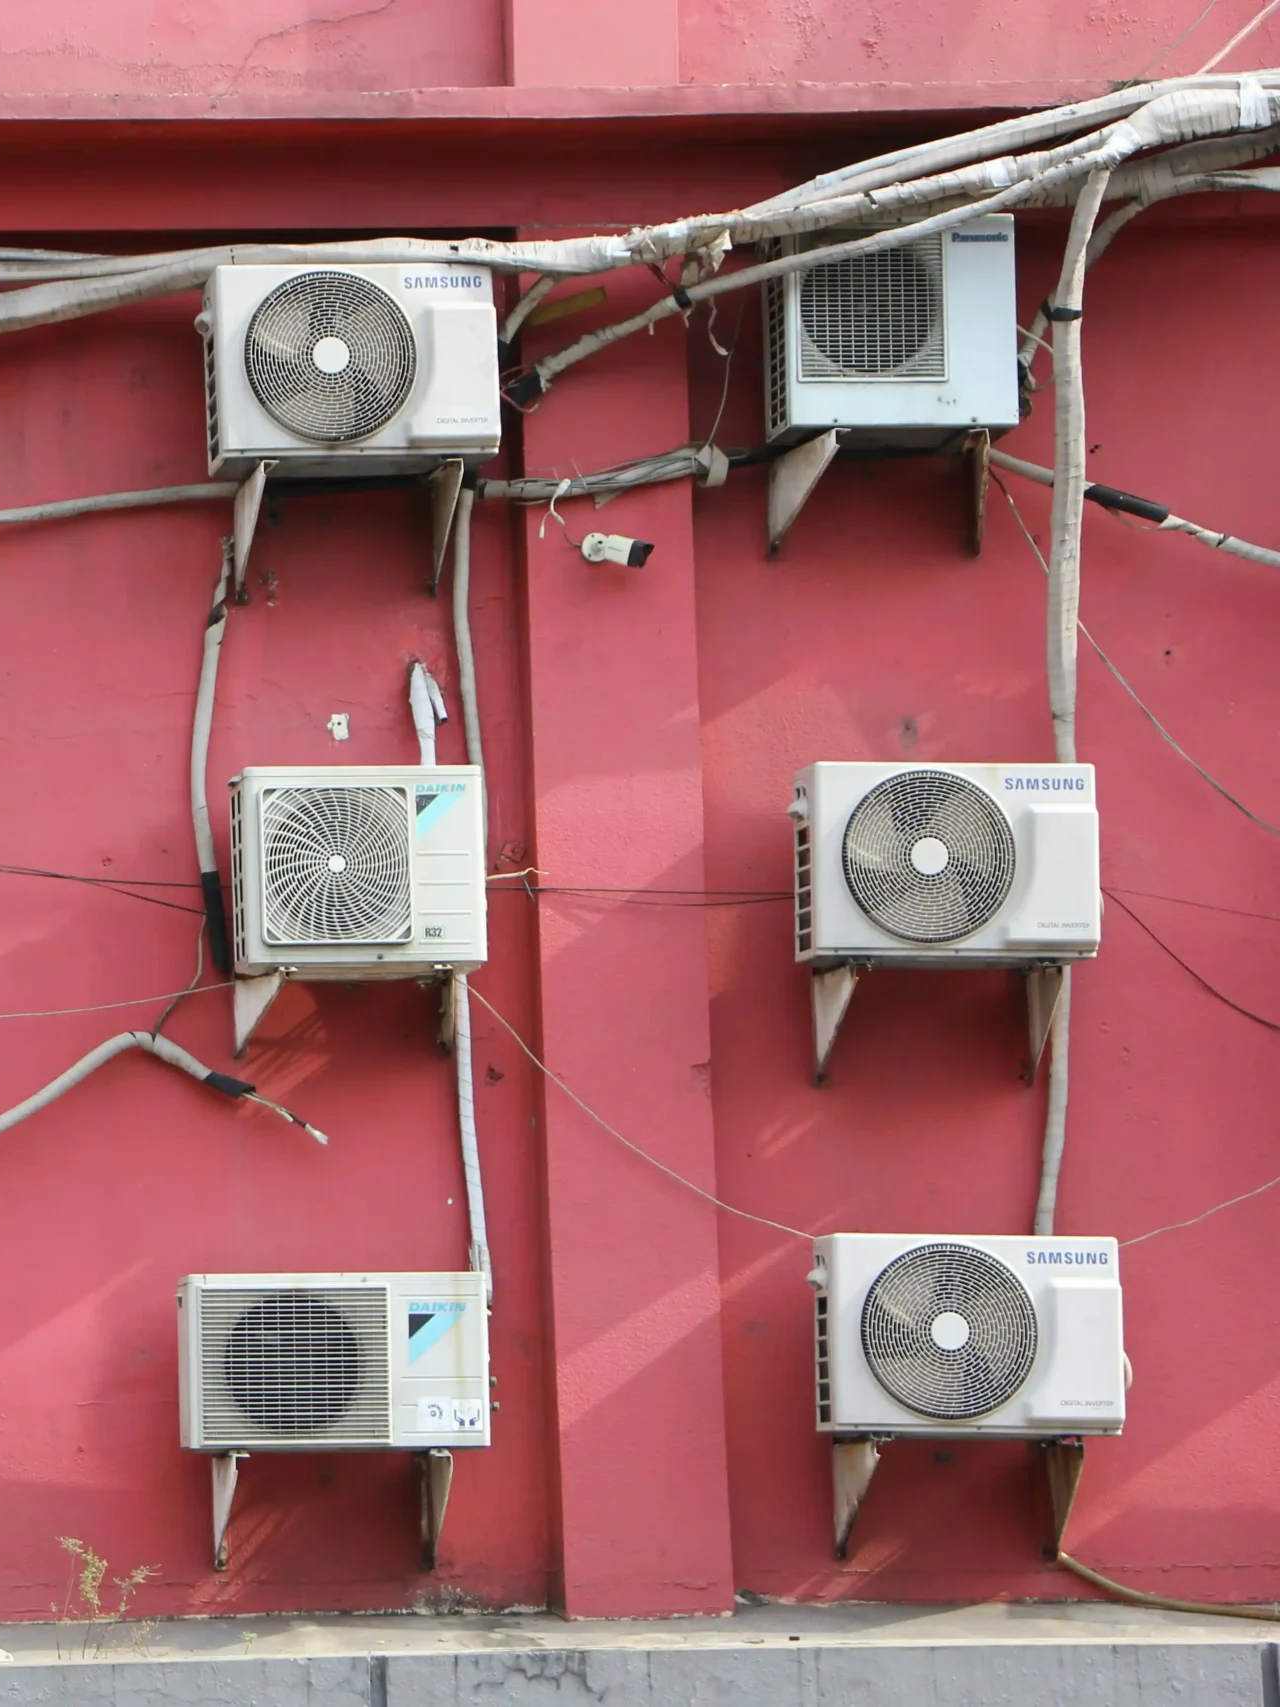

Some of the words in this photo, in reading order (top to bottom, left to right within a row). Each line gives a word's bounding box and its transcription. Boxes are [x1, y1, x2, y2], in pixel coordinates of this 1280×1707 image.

[951, 232, 1008, 242] Panasonic
[404, 276, 482, 289] SAMSUNG
[415, 784, 466, 793] DAIKIN
[1004, 778, 1085, 790] SAMSUNG
[425, 927, 442, 938] R32
[1027, 1251, 1108, 1265] SAMSUNG
[408, 1302, 466, 1312] DAIKIN
